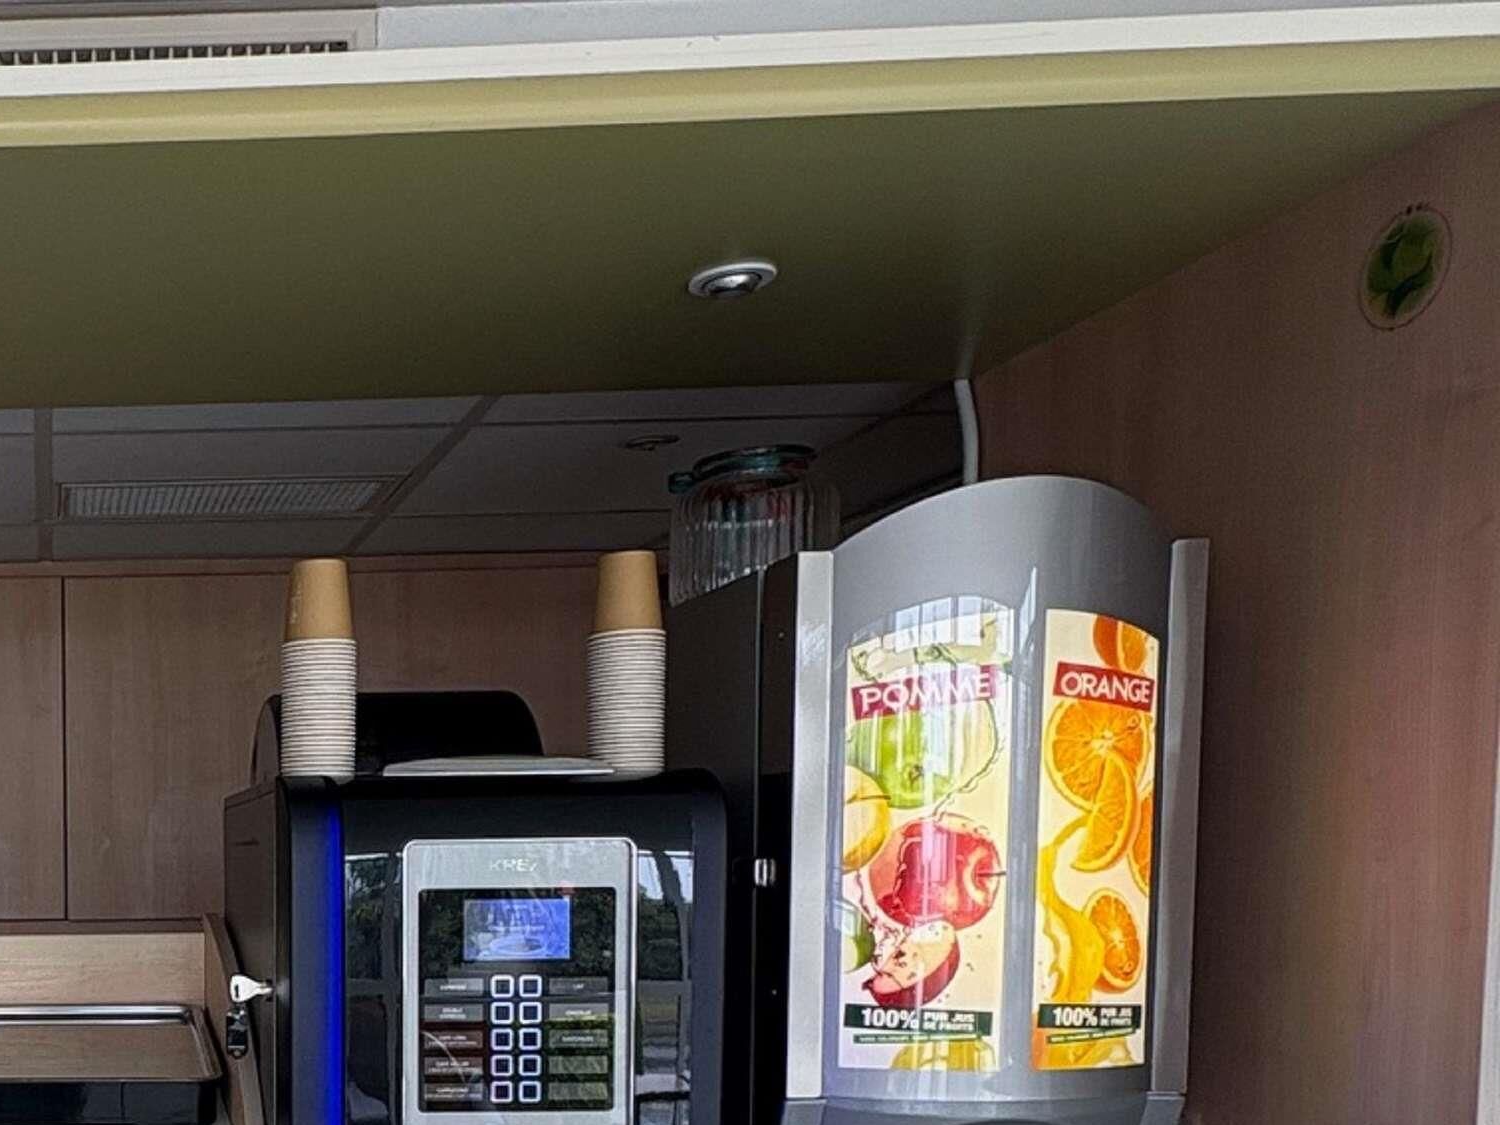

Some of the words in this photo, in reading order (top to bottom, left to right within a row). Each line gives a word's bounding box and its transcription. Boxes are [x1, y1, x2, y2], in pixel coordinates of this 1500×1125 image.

[859, 671, 991, 712] POMME
[1060, 671, 1150, 703] ORANGE
[861, 1007, 919, 1030] 100%
[1052, 1007, 1098, 1027] 100%
